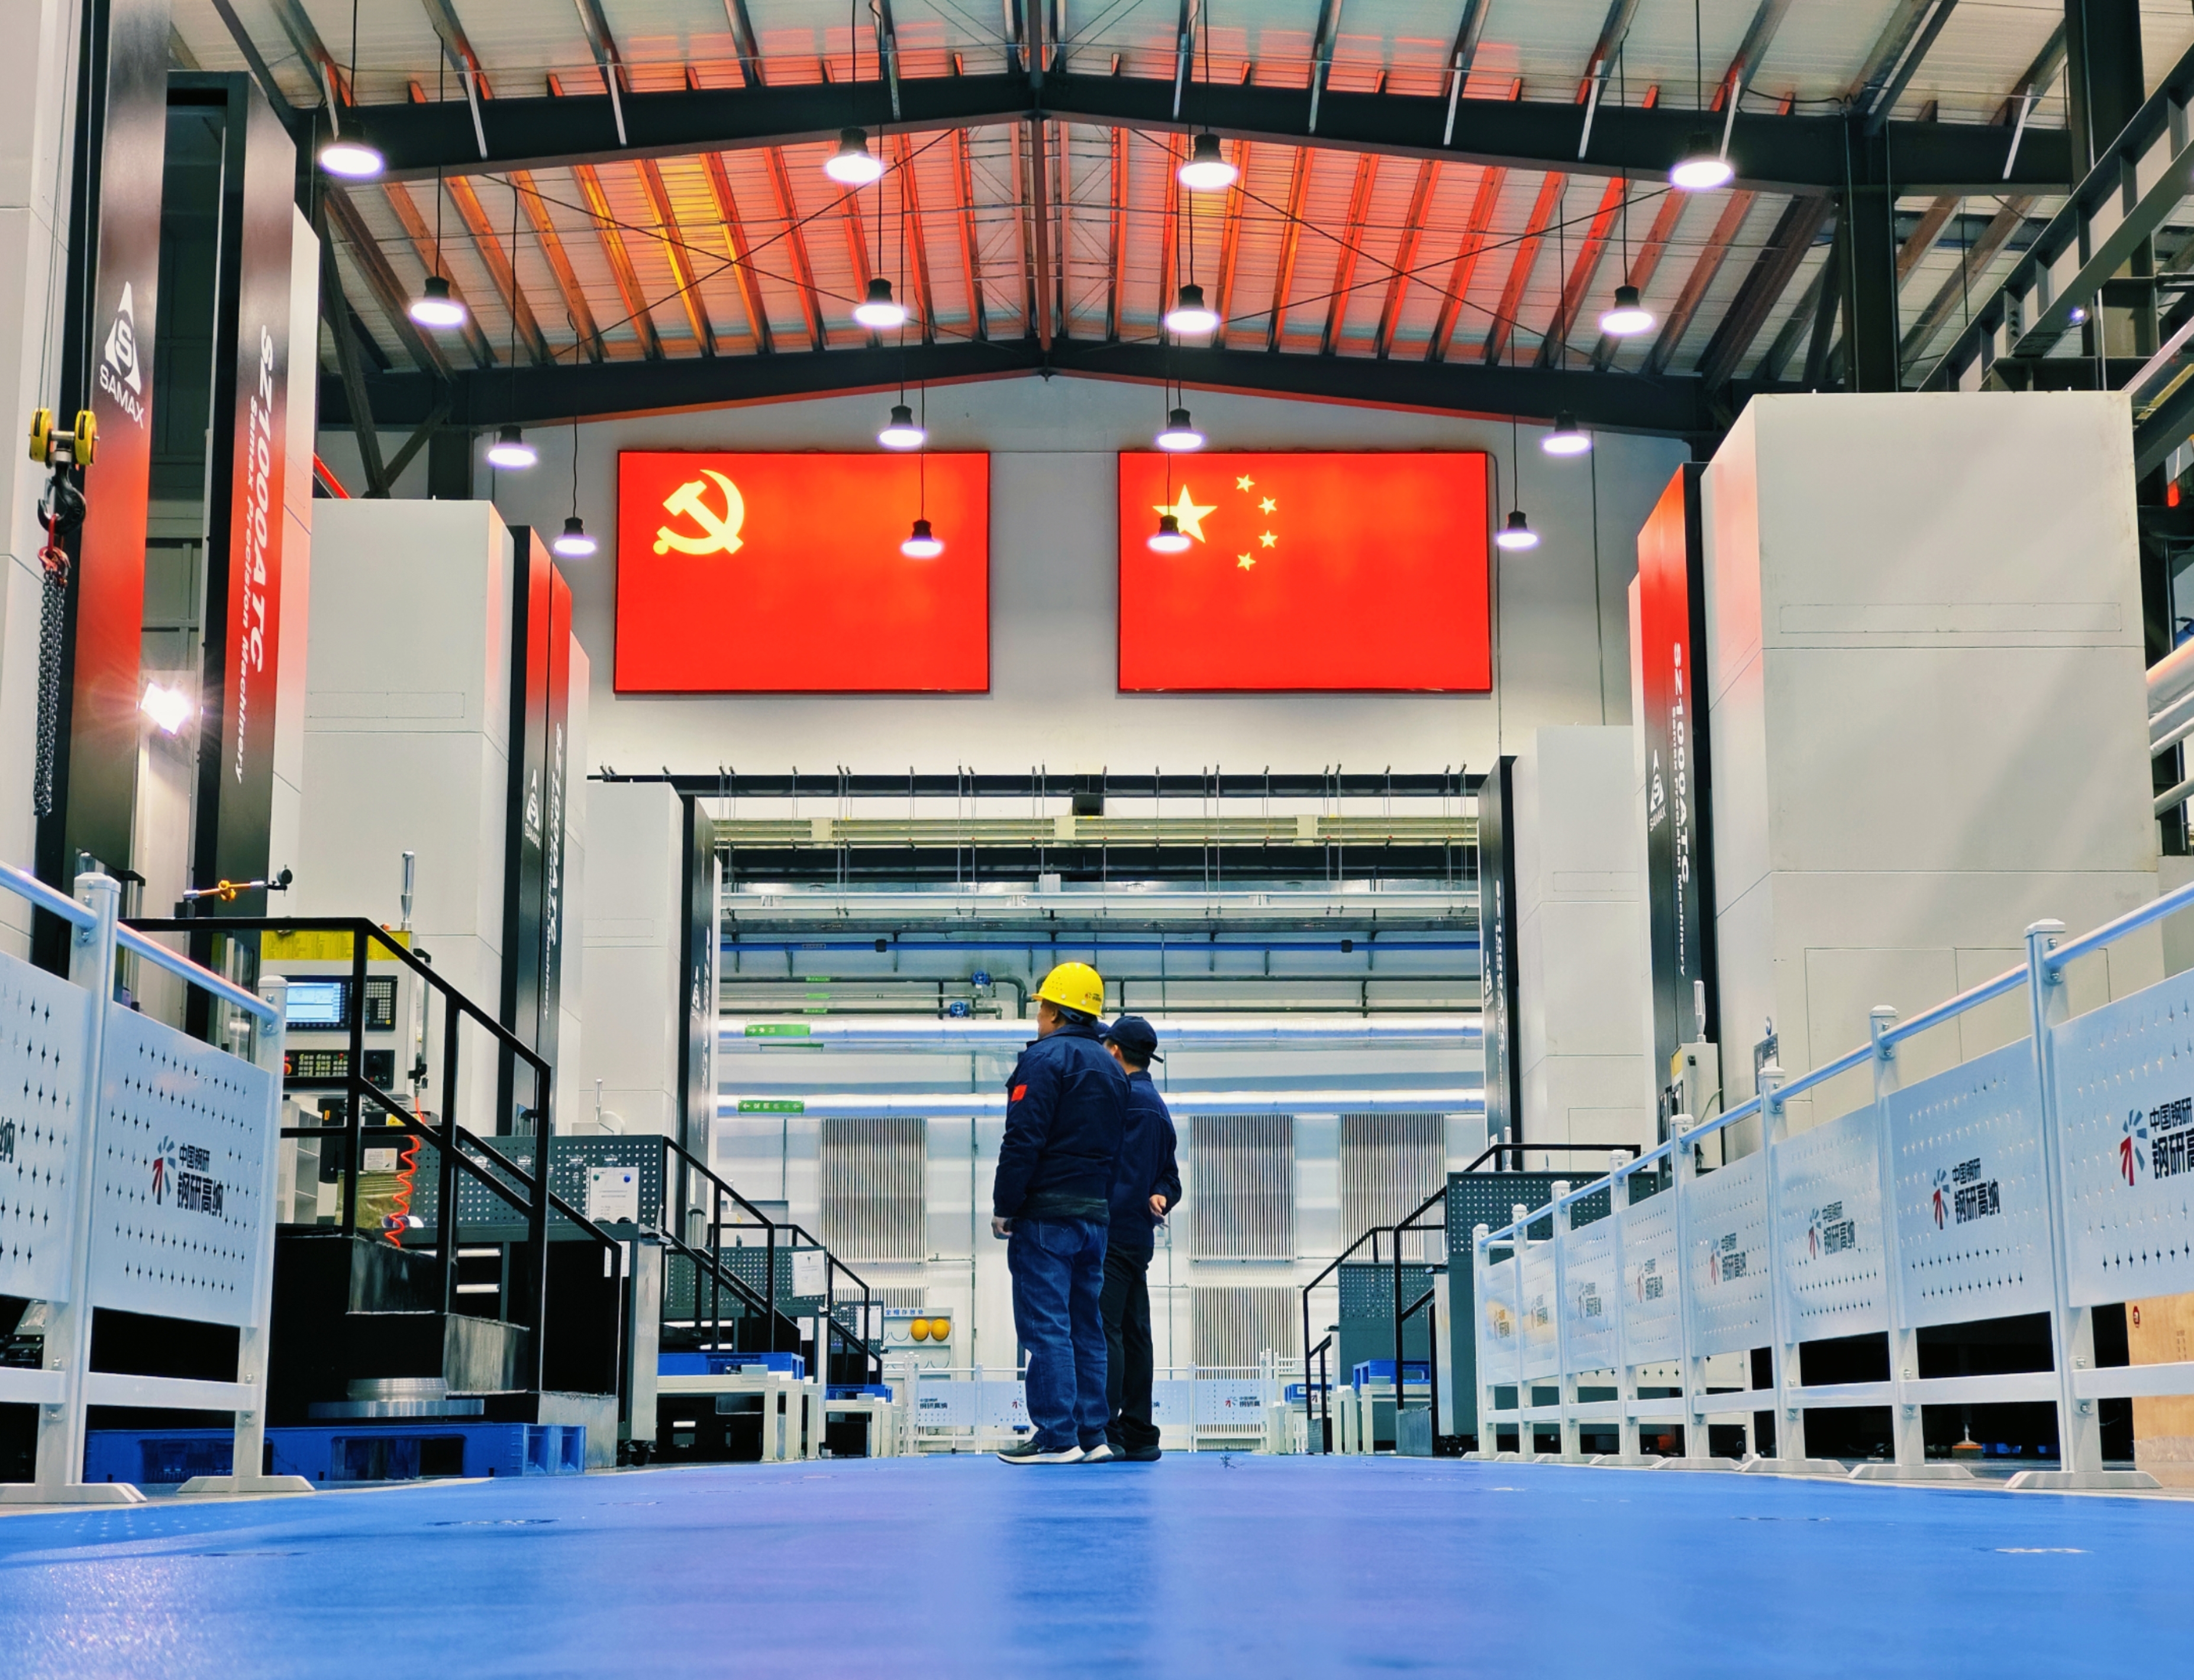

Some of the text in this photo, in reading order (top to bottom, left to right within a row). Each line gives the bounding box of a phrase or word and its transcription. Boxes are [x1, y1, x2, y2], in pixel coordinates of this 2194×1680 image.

[99, 364, 144, 429] SAMAX
[251, 325, 273, 672] SZ1000ATC
[235, 395, 257, 784] Samax Precision Machinery
[1673, 642, 1689, 883] SZ1000ATC
[525, 823, 541, 850] SAMAX
[550, 722, 562, 946] SZ1000ATC
[1649, 803, 1666, 832] SAMAX
[2149, 1097, 2193, 1133] 中国钢研
[179, 1143, 210, 1174] 中国钢研
[1952, 1158, 1981, 1186] 中国钢研
[178, 1171, 224, 1218] 钢研高纳
[1954, 1178, 2001, 1225] 钢研高纳
[1824, 1218, 1855, 1255] 钢研高纳
